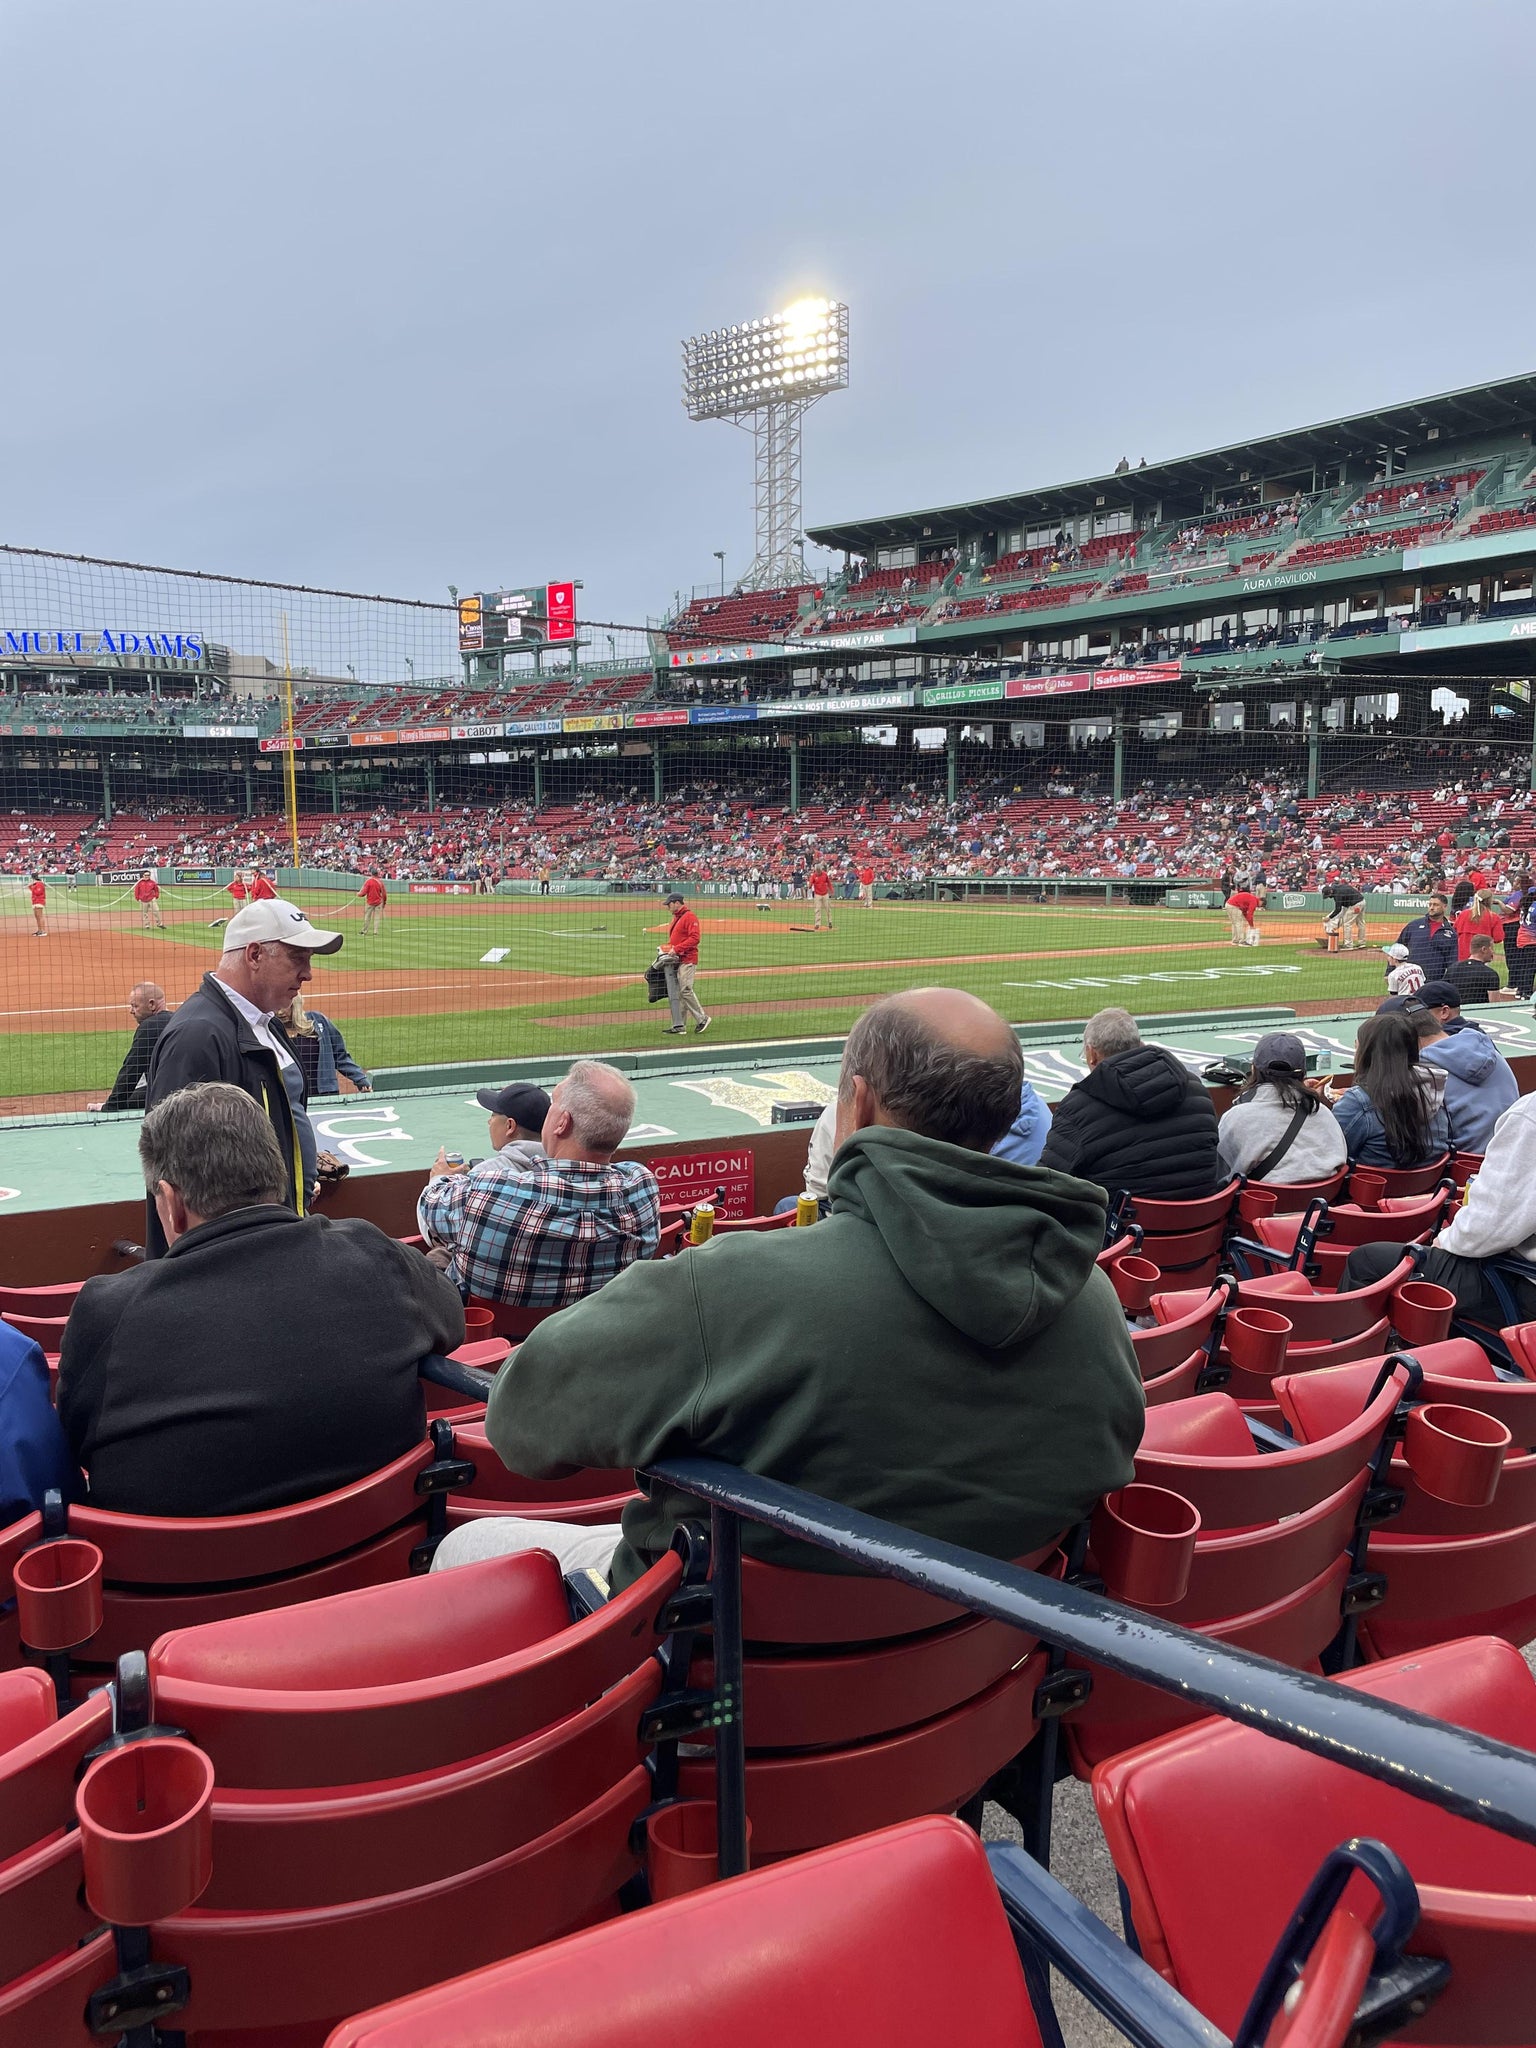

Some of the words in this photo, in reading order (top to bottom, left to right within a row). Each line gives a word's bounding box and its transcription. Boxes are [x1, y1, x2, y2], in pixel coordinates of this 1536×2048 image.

[1274, 571, 1317, 586] PAVILION
[1510, 621, 1536, 637] AME
[95, 628, 203, 661] ADAMS
[831, 637, 862, 647] FENWAY
[864, 634, 885, 644] PARK
[1023, 682, 1045, 692] Ninety
[1058, 679, 1073, 688] Nine
[1096, 673, 1136, 685] Safelite
[969, 686, 1000, 698] PICKLES
[806, 702, 824, 711] MOST
[827, 699, 859, 710] BELOVED
[862, 695, 902, 707] BALLPARK
[209, 727, 232, 737] 6:34
[364, 734, 384, 743] STIHL
[703, 884, 715, 894] JIM
[1408, 976, 1421, 994] 11
[655, 1157, 749, 1180] CAUTION!
[659, 1192, 675, 1201] TAY
[679, 1187, 710, 1198] CLEAR
[731, 1184, 748, 1192] NET
[728, 1196, 747, 1205] FOR
[1300, 1235, 1309, 1247] F
